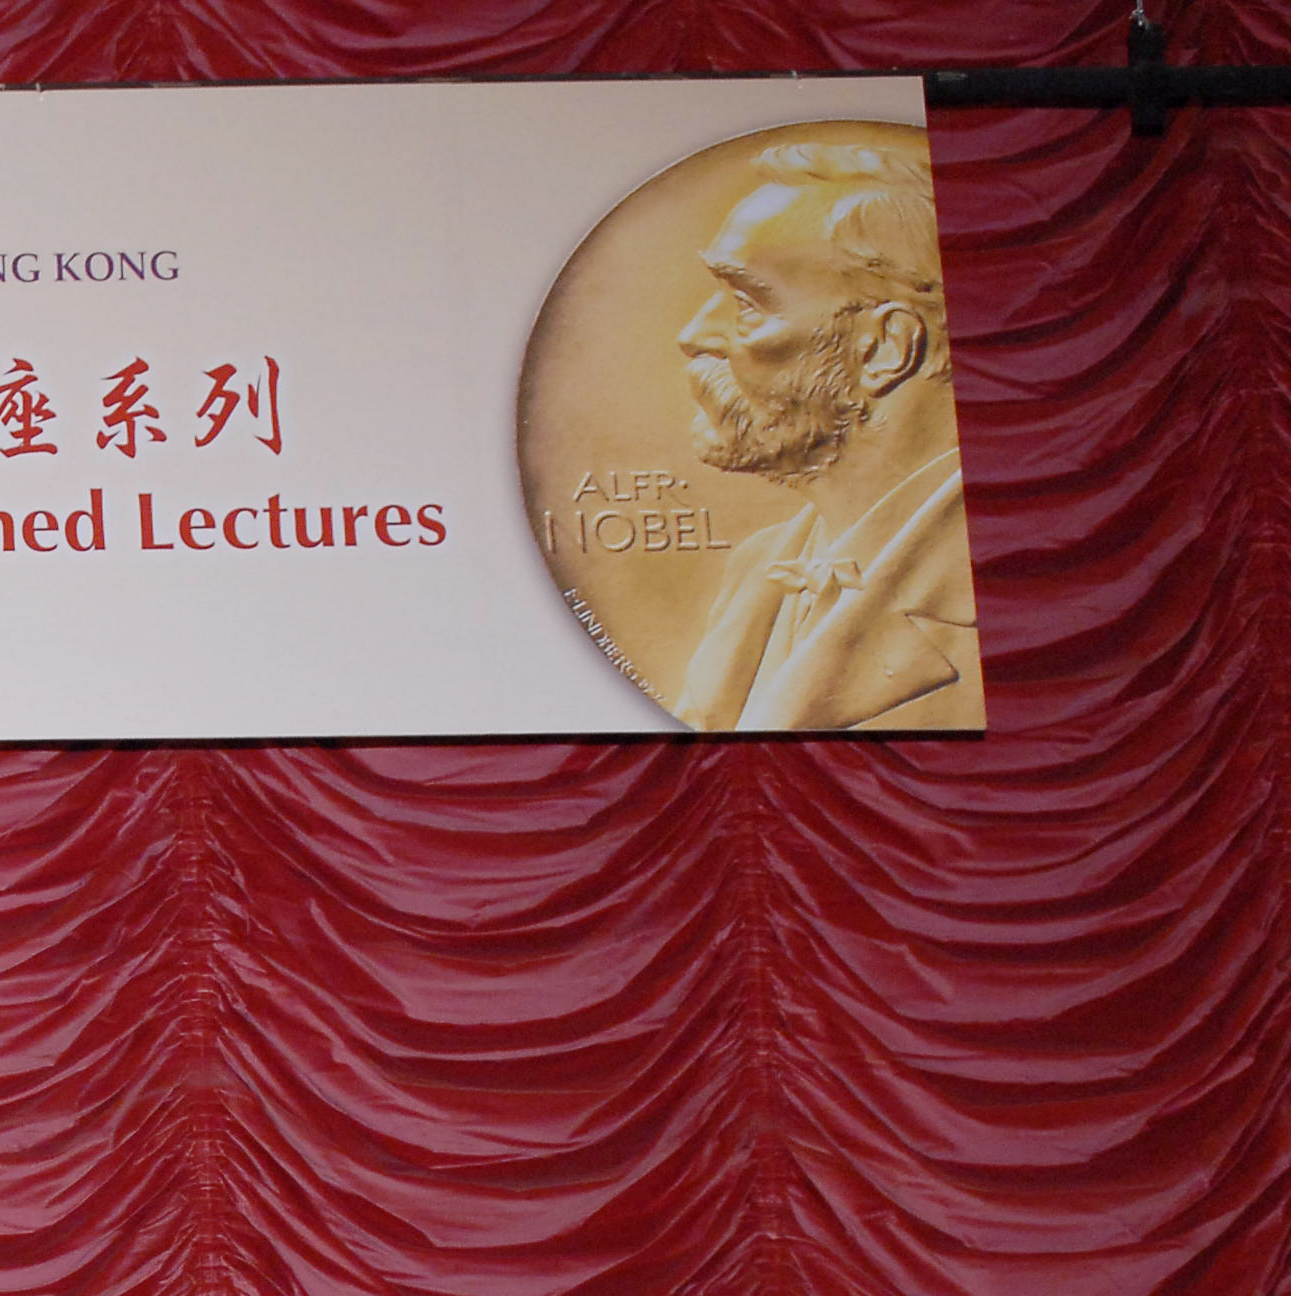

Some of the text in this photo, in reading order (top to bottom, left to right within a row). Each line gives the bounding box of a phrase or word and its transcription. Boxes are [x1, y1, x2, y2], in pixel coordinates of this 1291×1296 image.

[54, 251, 179, 281] KONG
[139, 493, 446, 550] Lectures
[544, 508, 731, 554] NOBEL
